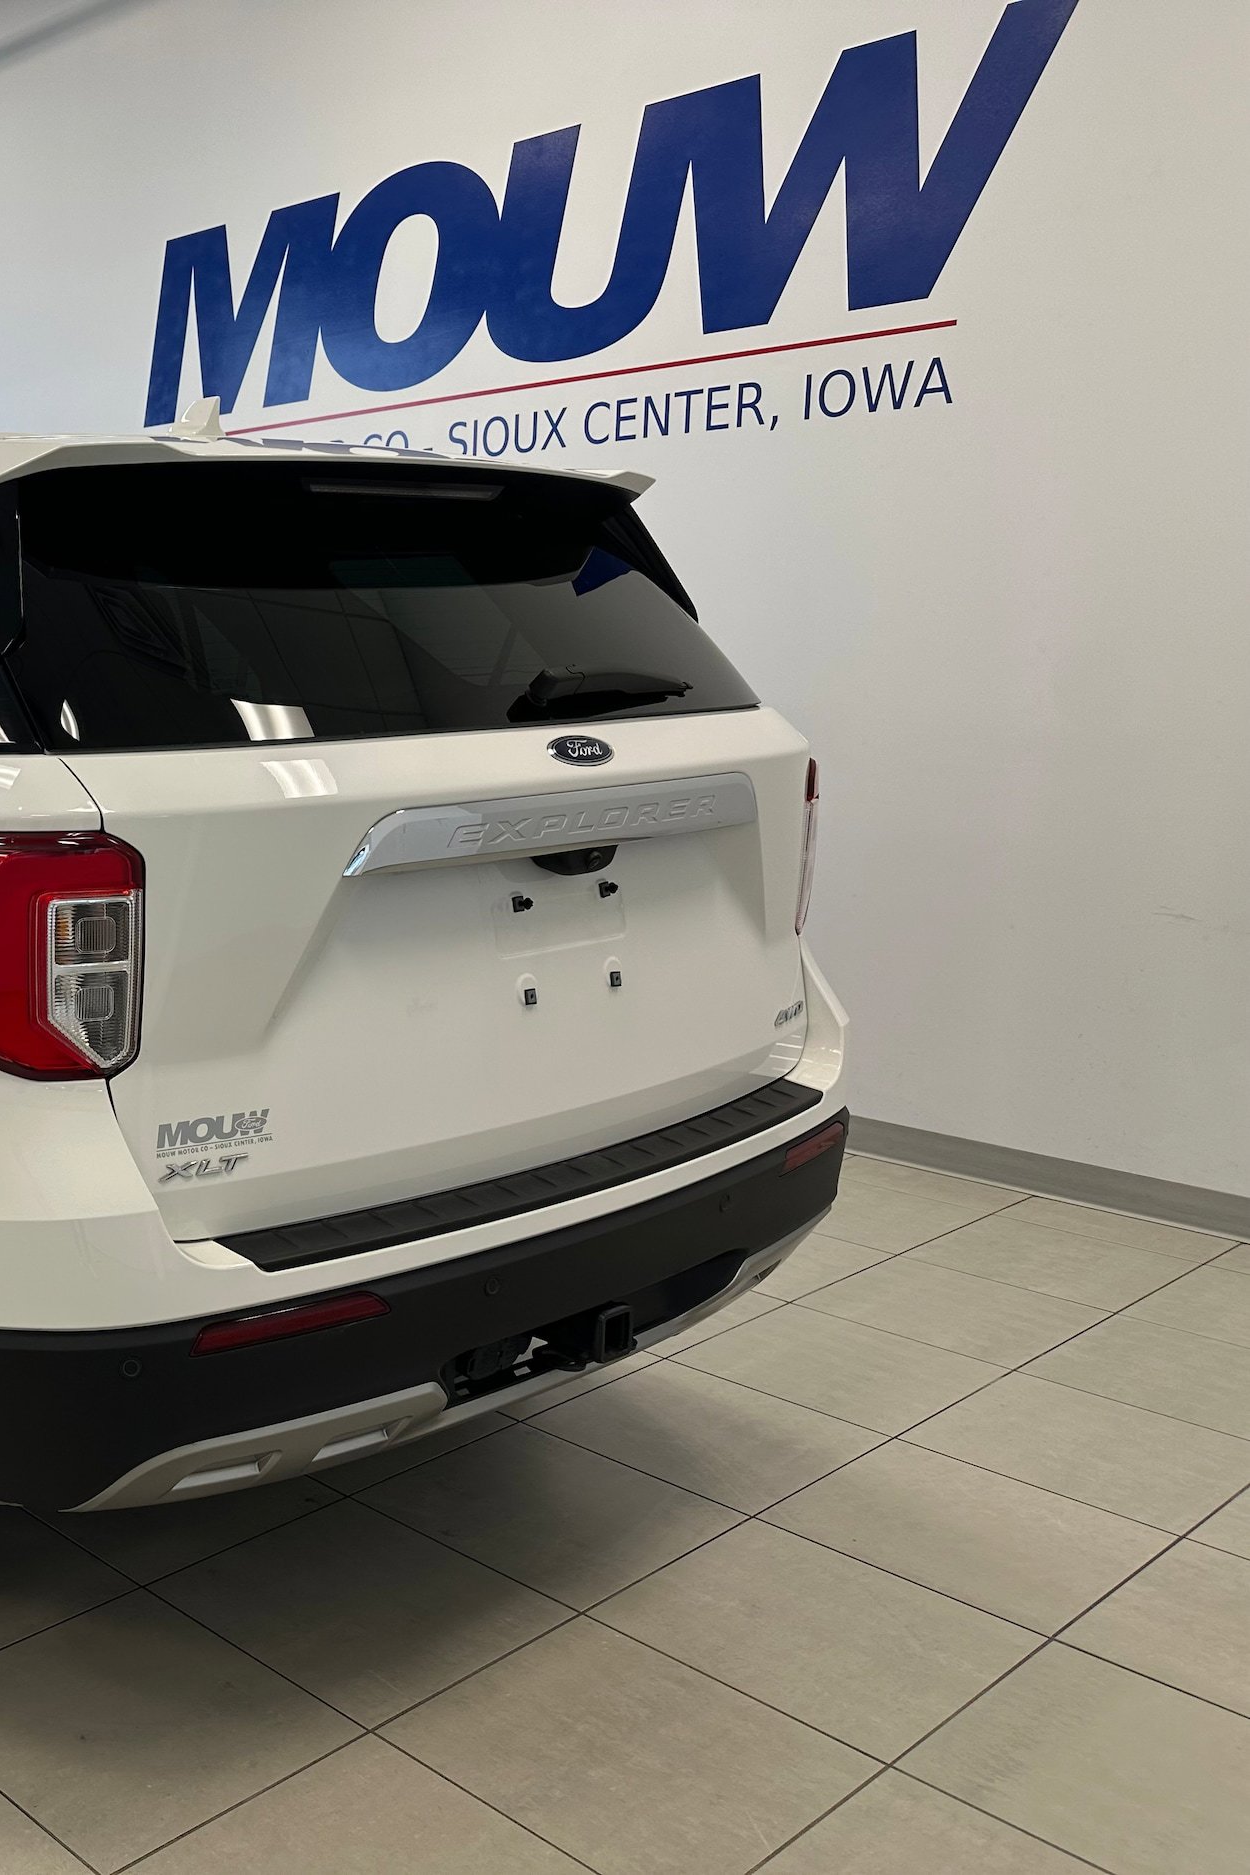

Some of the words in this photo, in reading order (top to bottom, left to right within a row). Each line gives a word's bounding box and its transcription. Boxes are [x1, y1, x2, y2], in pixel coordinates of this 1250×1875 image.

[144, 0, 1079, 428] MOUW
[448, 407, 568, 457] SIOUX
[583, 381, 779, 445] CENTER,
[803, 357, 953, 420] IOWA
[566, 739, 603, 758] Ford
[447, 794, 716, 848] EXPLORER
[156, 1150, 176, 1159] MOUW
[177, 1147, 199, 1156] MOTOR
[158, 1152, 249, 1183] XLT
